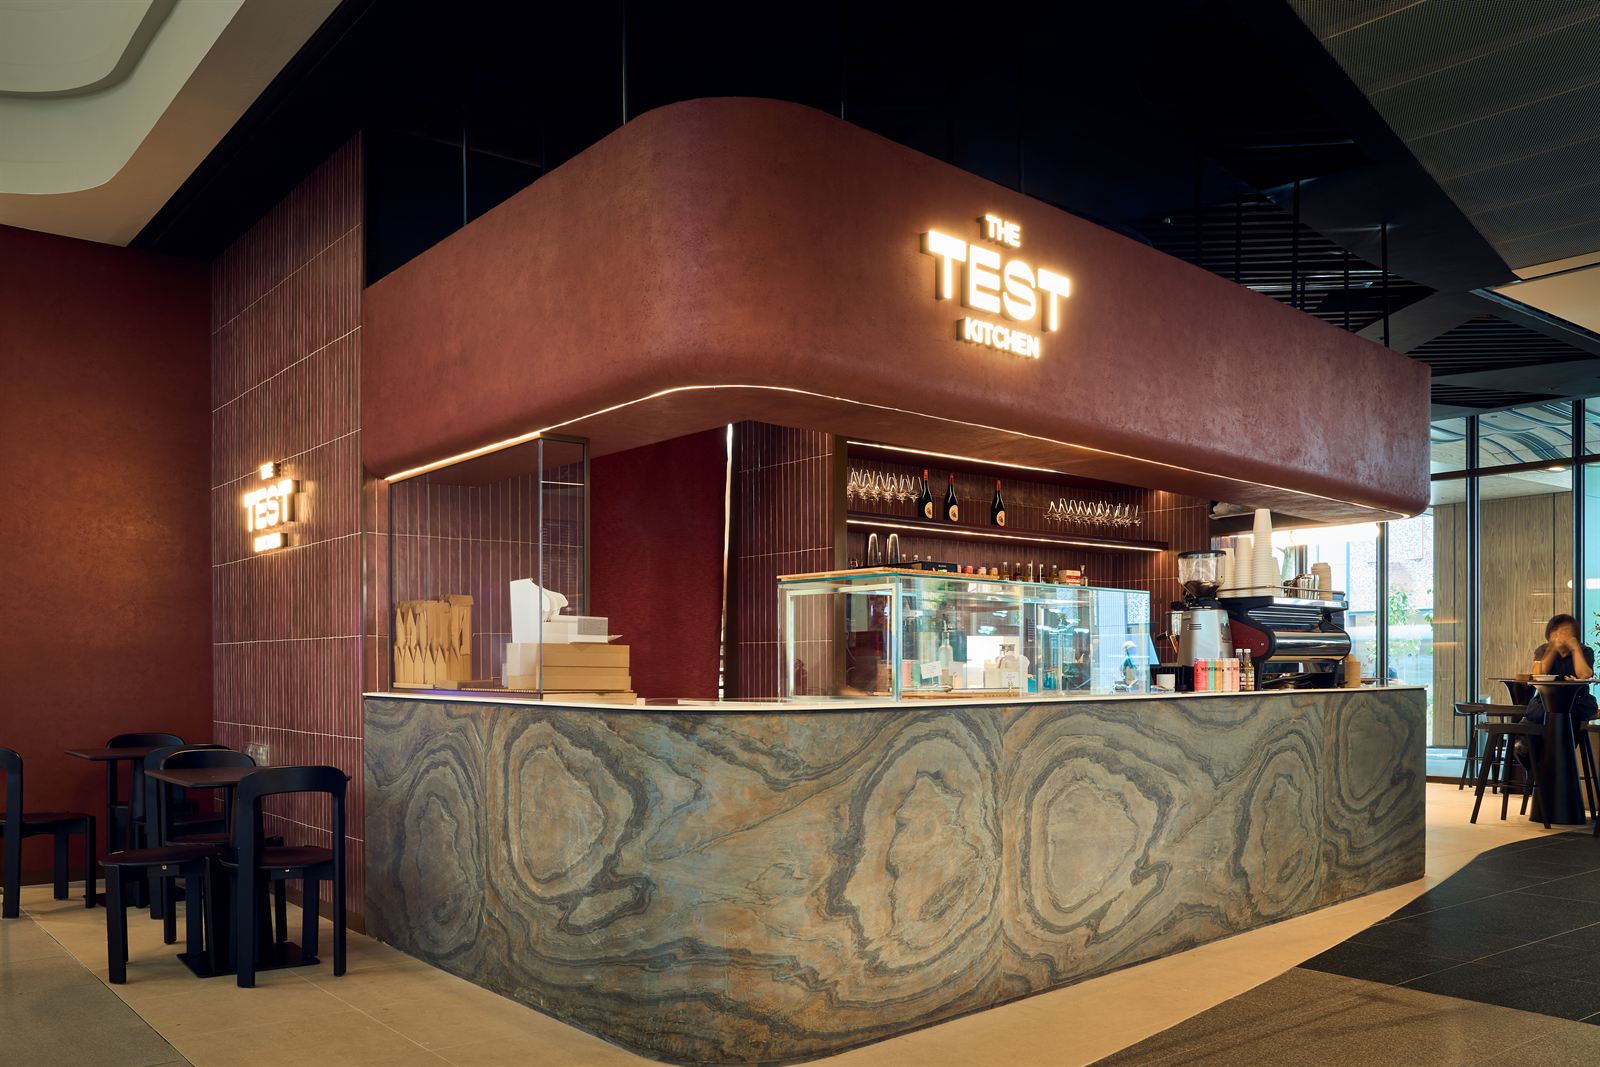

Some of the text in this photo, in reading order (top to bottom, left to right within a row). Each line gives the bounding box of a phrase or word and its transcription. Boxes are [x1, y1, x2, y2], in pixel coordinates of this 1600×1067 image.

[985, 214, 1021, 247] THE
[928, 229, 1071, 332] TEST
[965, 316, 1040, 359] KITCHEN
[243, 479, 293, 533] TEST
